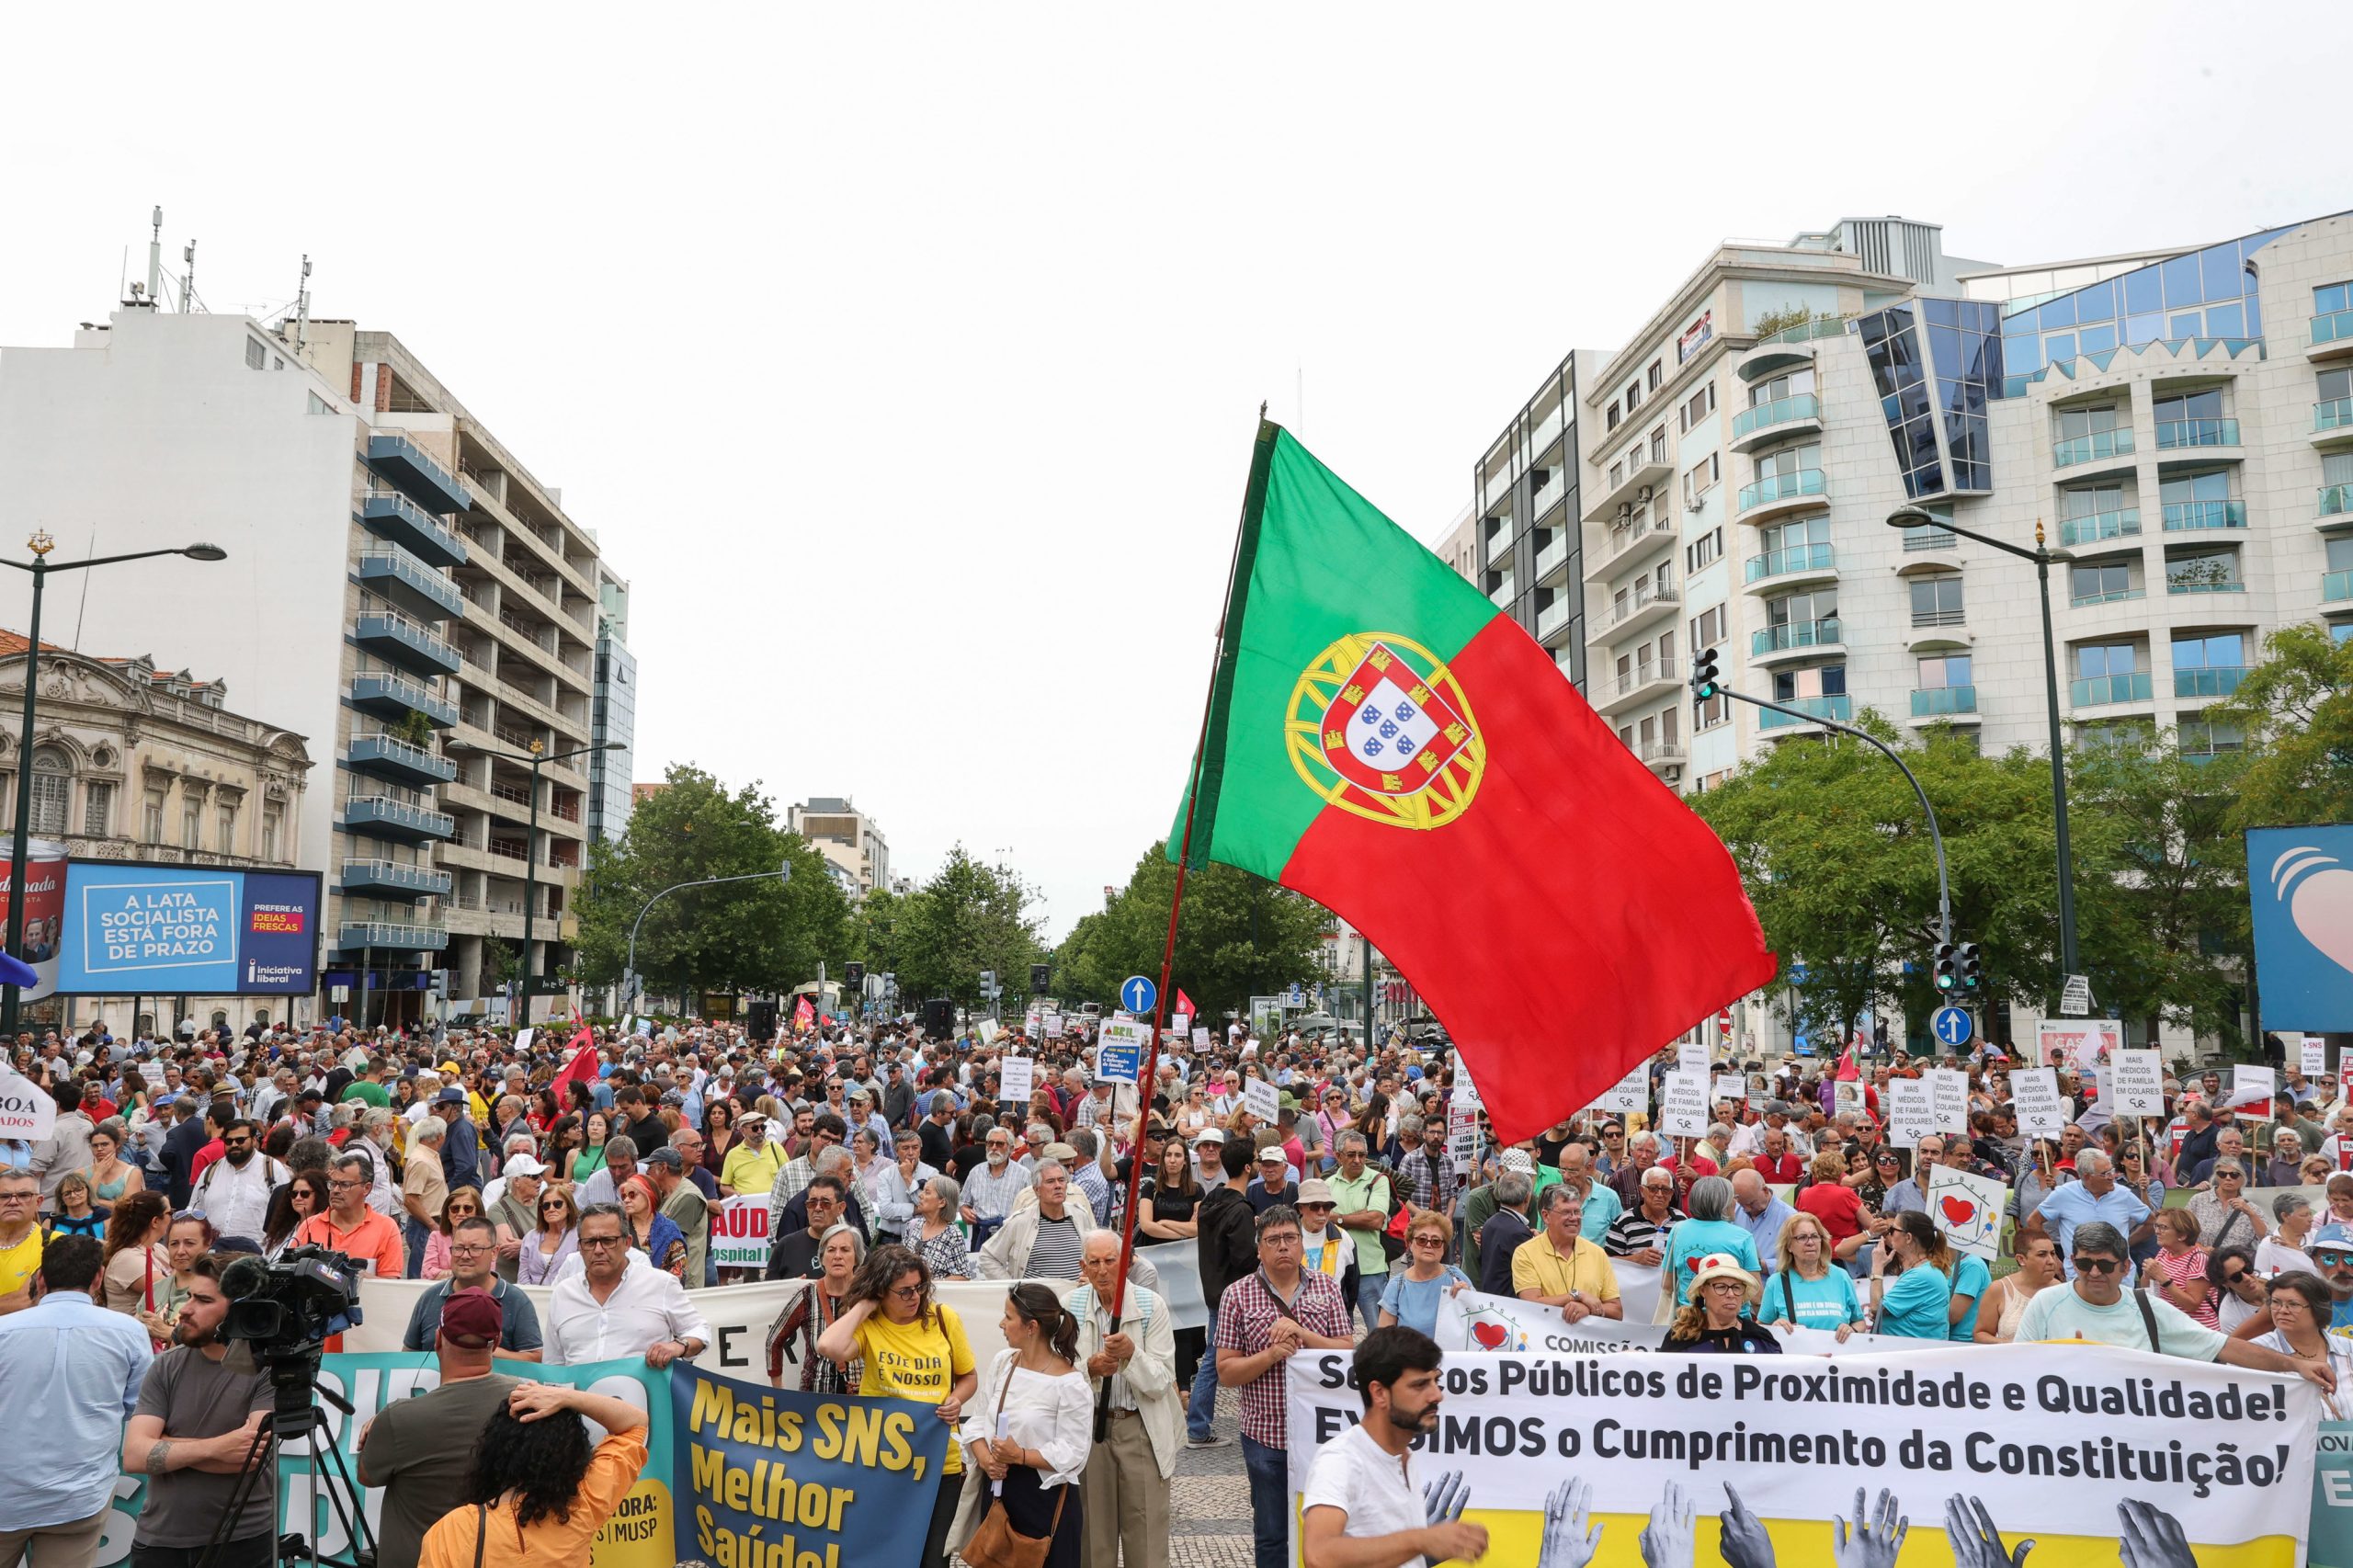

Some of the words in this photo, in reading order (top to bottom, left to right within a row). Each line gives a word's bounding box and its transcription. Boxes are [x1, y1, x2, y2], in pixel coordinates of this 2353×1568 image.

[125, 895, 140, 909] A
[147, 892, 198, 908] LATA
[255, 903, 290, 913] PREFERE
[100, 908, 220, 927] SOCIALISTA
[254, 913, 287, 923] IDEIAS
[253, 922, 299, 932] FRESCAS
[104, 923, 155, 944] ESTÁ
[162, 923, 218, 940] FORA
[108, 945, 137, 960] DE
[143, 938, 214, 958] PRAZO
[257, 965, 302, 975] iniciativa
[257, 973, 289, 983] liberal
[2120, 1066, 2151, 1074] MÉDICOS
[1672, 1087, 1699, 1096] MÉDICOS
[1936, 1083, 1959, 1092] ÉDICOS
[2019, 1084, 2048, 1093] MÉDICOS
[1678, 1097, 1701, 1107] FAMÍLIA
[1897, 1095, 1926, 1104] MÉDICOS
[1937, 1094, 1961, 1102] FAMÍLIA
[1677, 1108, 1705, 1117] COLARES
[1904, 1106, 1928, 1114] FAMÍLIA
[1936, 1104, 1964, 1112] COLARES
[2028, 1105, 2057, 1113] COLARES
[1453, 1117, 1466, 1125] DOS
[1460, 1134, 1481, 1143] LISBA
[1455, 1143, 1483, 1153] ORIENA
[711, 1247, 764, 1263] ospital
[879, 1351, 909, 1368] ESTE
[915, 1357, 941, 1369] DIA
[879, 1365, 884, 1381] É
[892, 1371, 941, 1386] NOSSO
[1499, 1359, 1665, 1399] Públicos
[1677, 1363, 1722, 1400] de
[1733, 1364, 1991, 1410] Proximidade
[2003, 1382, 2025, 1411] e
[2036, 1374, 2287, 1422] Qualidade!
[689, 1378, 803, 1452] Mais
[813, 1403, 926, 1481] SNS,
[1315, 1406, 1546, 1458] EIMOS
[1557, 1428, 1581, 1458] o
[1593, 1418, 1886, 1470] Cumprimento
[1899, 1428, 1952, 1471] da
[1965, 1431, 2290, 1499] Constituição!
[691, 1442, 854, 1532] Melhor
[616, 1518, 657, 1542] MUSP
